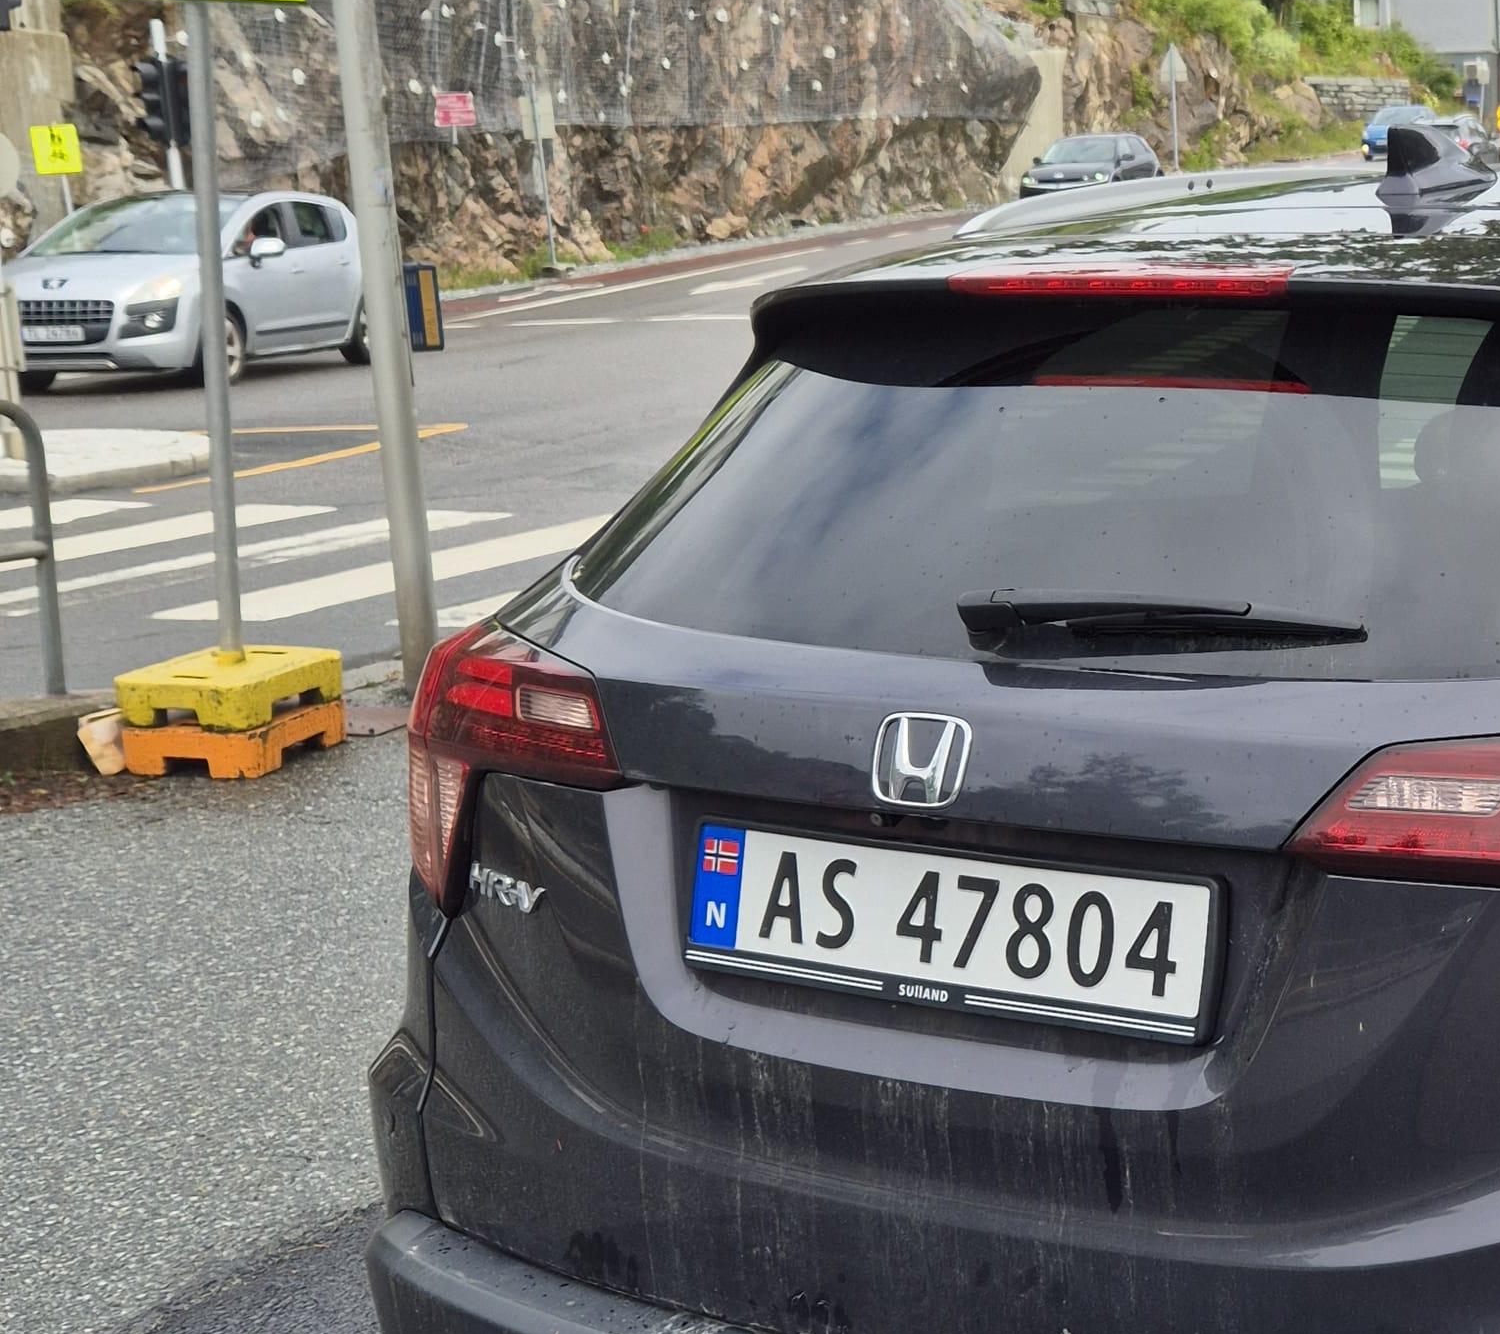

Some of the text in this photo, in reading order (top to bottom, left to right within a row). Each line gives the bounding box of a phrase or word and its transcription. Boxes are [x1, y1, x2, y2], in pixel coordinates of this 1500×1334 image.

[705, 850, 1177, 998] N AS 47804
